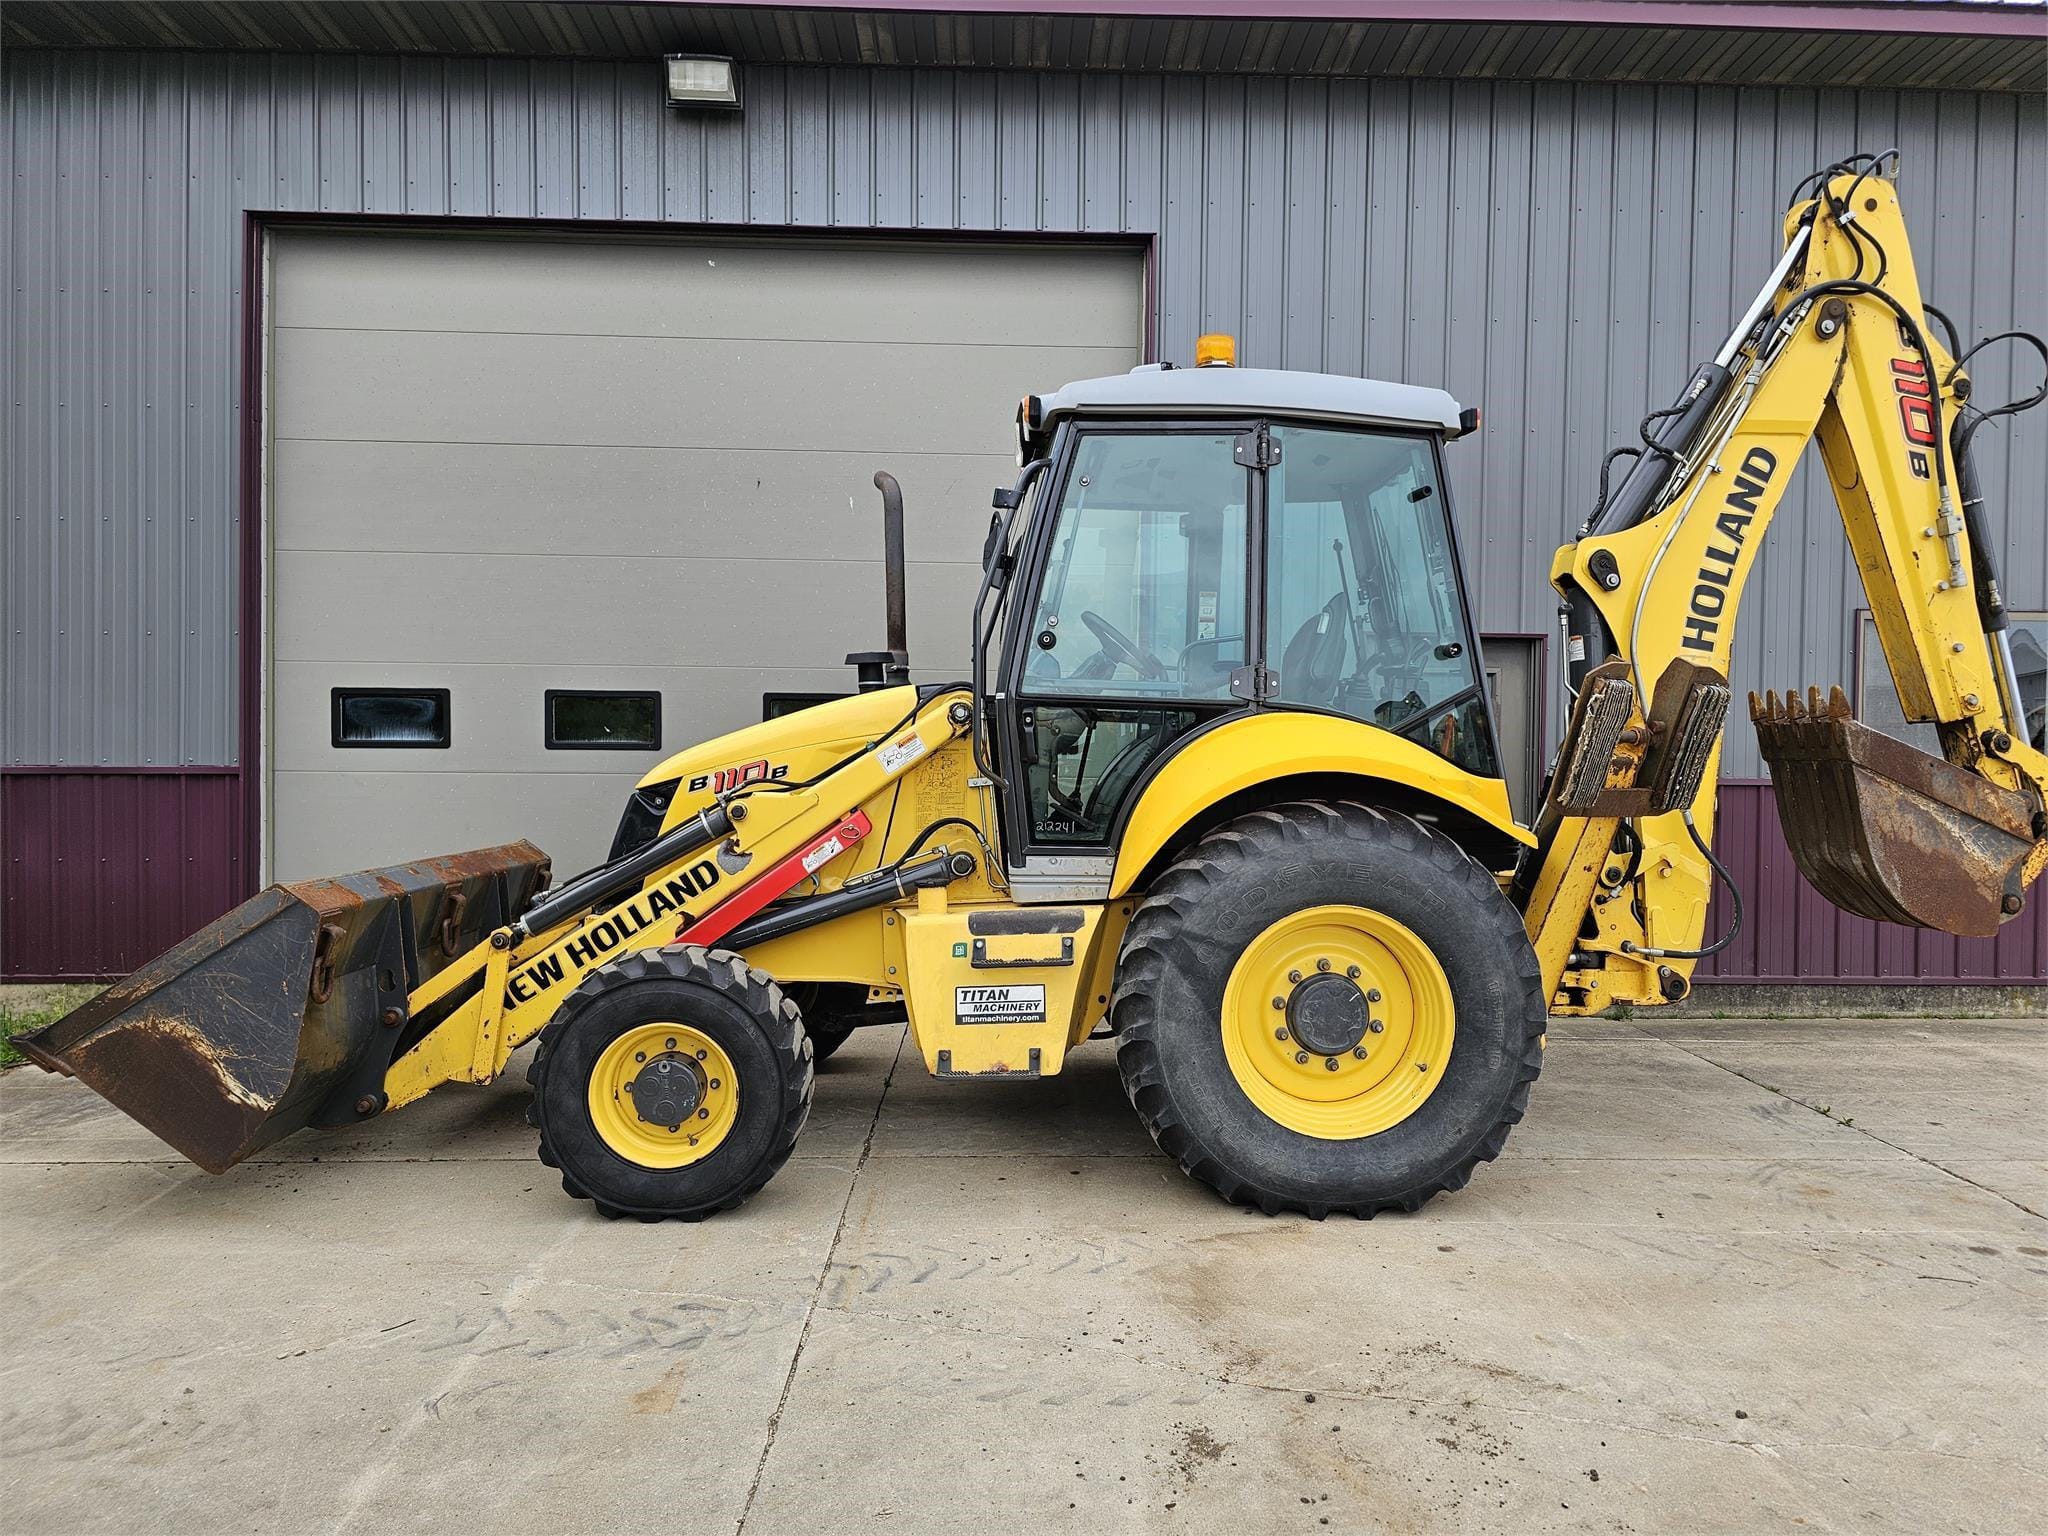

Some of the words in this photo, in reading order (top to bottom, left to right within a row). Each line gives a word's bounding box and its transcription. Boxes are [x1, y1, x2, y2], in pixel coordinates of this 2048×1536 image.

[1890, 358, 1935, 448] 110
[1908, 450, 1930, 480] B
[1681, 447, 1777, 653] HOLLAND
[688, 775, 709, 793] B
[713, 759, 769, 794] 110
[771, 764, 789, 780] B
[564, 859, 720, 969] HOLLAND
[960, 988, 1010, 1002] TITAN
[972, 1002, 1040, 1013] MACHINERY
[962, 1014, 1040, 1023] titanmachinery.com
